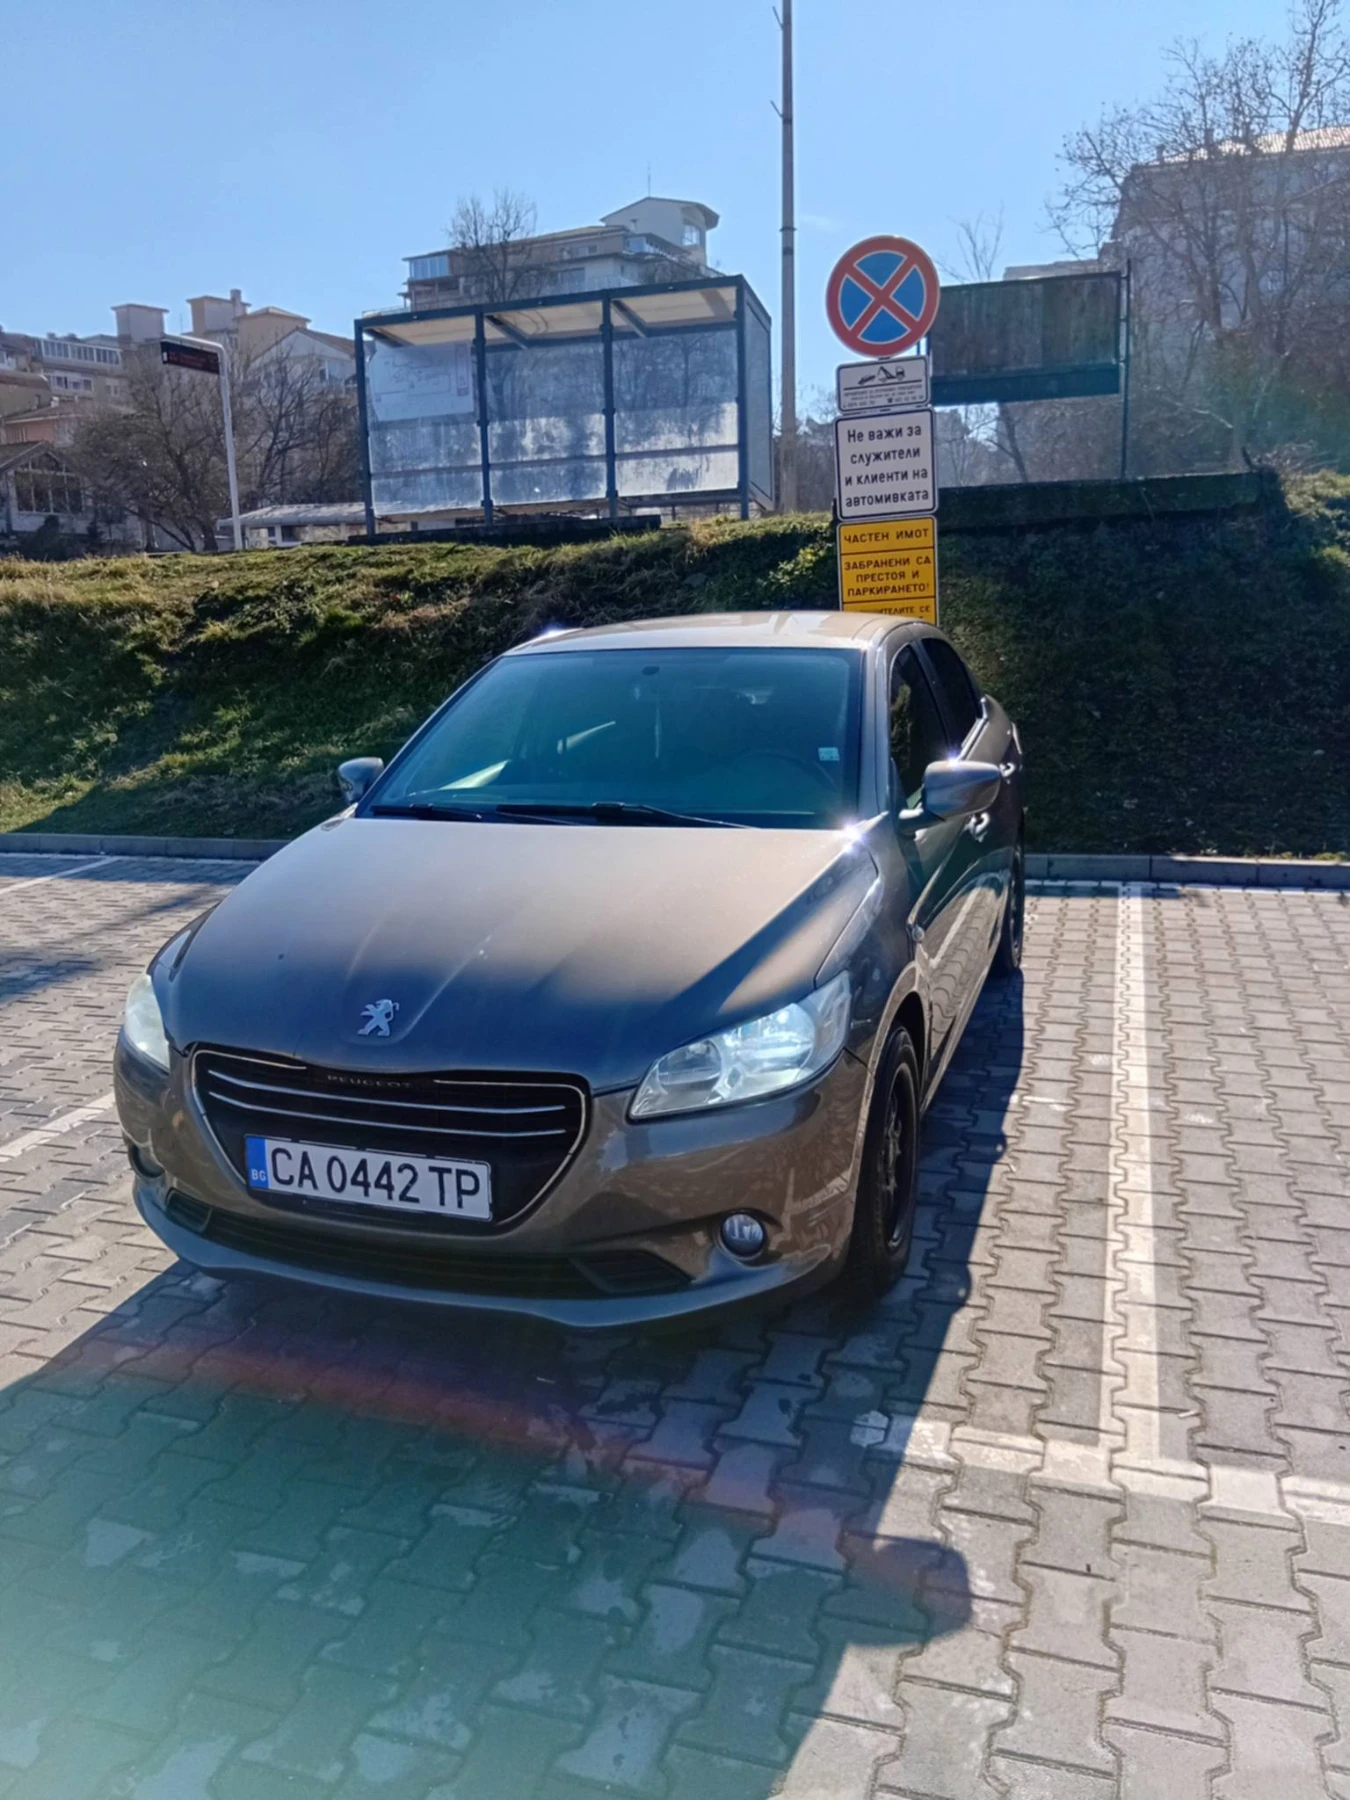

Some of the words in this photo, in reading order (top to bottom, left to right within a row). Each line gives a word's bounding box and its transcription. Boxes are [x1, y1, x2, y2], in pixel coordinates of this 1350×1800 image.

[847, 429, 864, 443] Не
[868, 427, 903, 441] важи
[906, 425, 922, 437] за
[850, 447, 921, 466] служители
[844, 476, 852, 486] и
[856, 470, 908, 485] клиенти
[912, 468, 928, 480] на
[845, 489, 929, 508] автомивката
[844, 532, 889, 543] ЧАСТЕН
[896, 528, 929, 540] ИМОТ
[844, 557, 910, 571] ЗАБРАНЕНИ
[916, 555, 931, 565] СА
[856, 571, 906, 583] ПРЕСТОЯ
[911, 570, 919, 579] И
[847, 583, 929, 597] ПАРКИРАНЕТО!
[327, 1075, 412, 1088] PEUGEOT
[251, 1168, 267, 1182] BG
[271, 1147, 318, 1191] CA
[327, 1155, 420, 1203] 0442
[428, 1165, 480, 1209] TP
